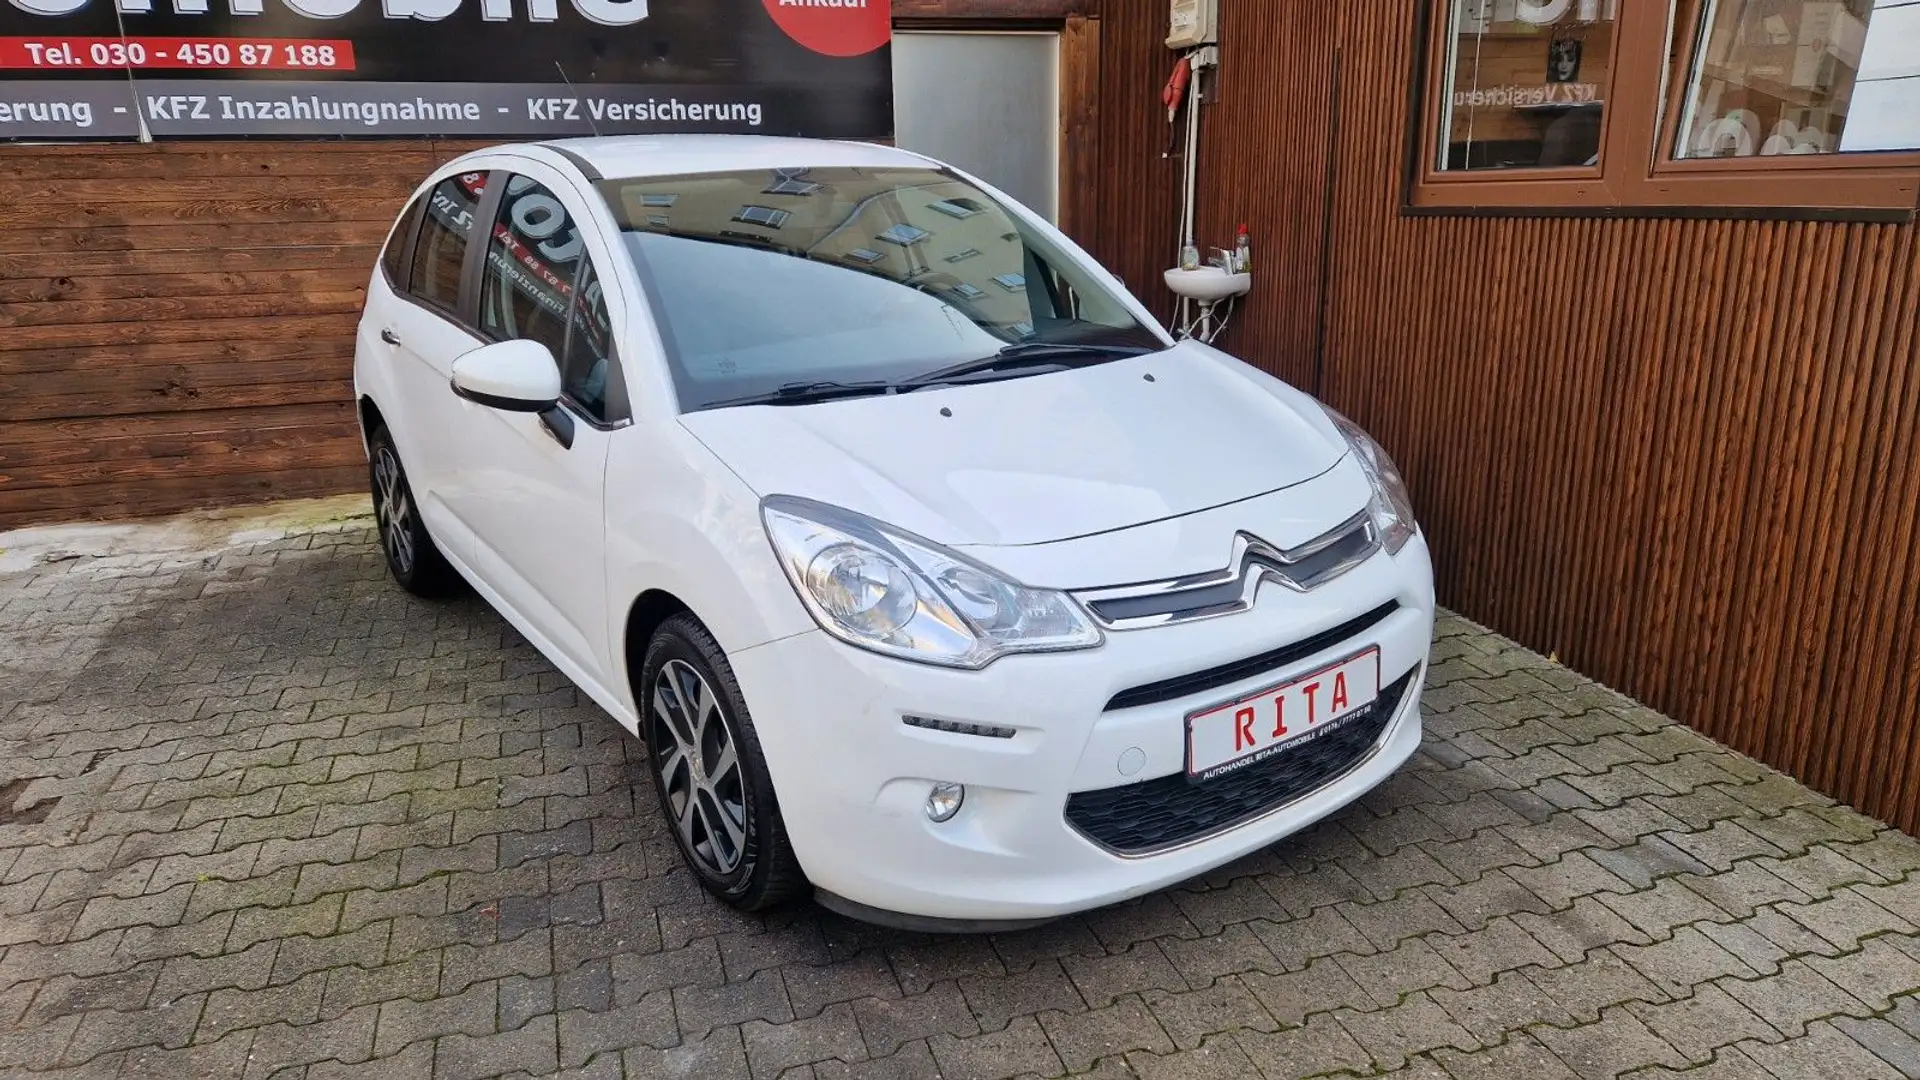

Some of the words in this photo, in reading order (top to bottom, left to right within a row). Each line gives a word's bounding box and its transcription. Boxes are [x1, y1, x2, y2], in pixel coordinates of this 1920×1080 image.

[24, 43, 82, 65] Tel.
[90, 43, 146, 65] 030
[177, 44, 230, 65] 450
[239, 45, 273, 66] 87
[284, 45, 336, 66] 188
[147, 96, 210, 119] KFZ
[219, 96, 481, 127] Inzahlungnahme
[527, 99, 579, 120] KFZ
[592, 98, 762, 125] Versicherung
[1203, 756, 1254, 780] AUTOHANDEL
